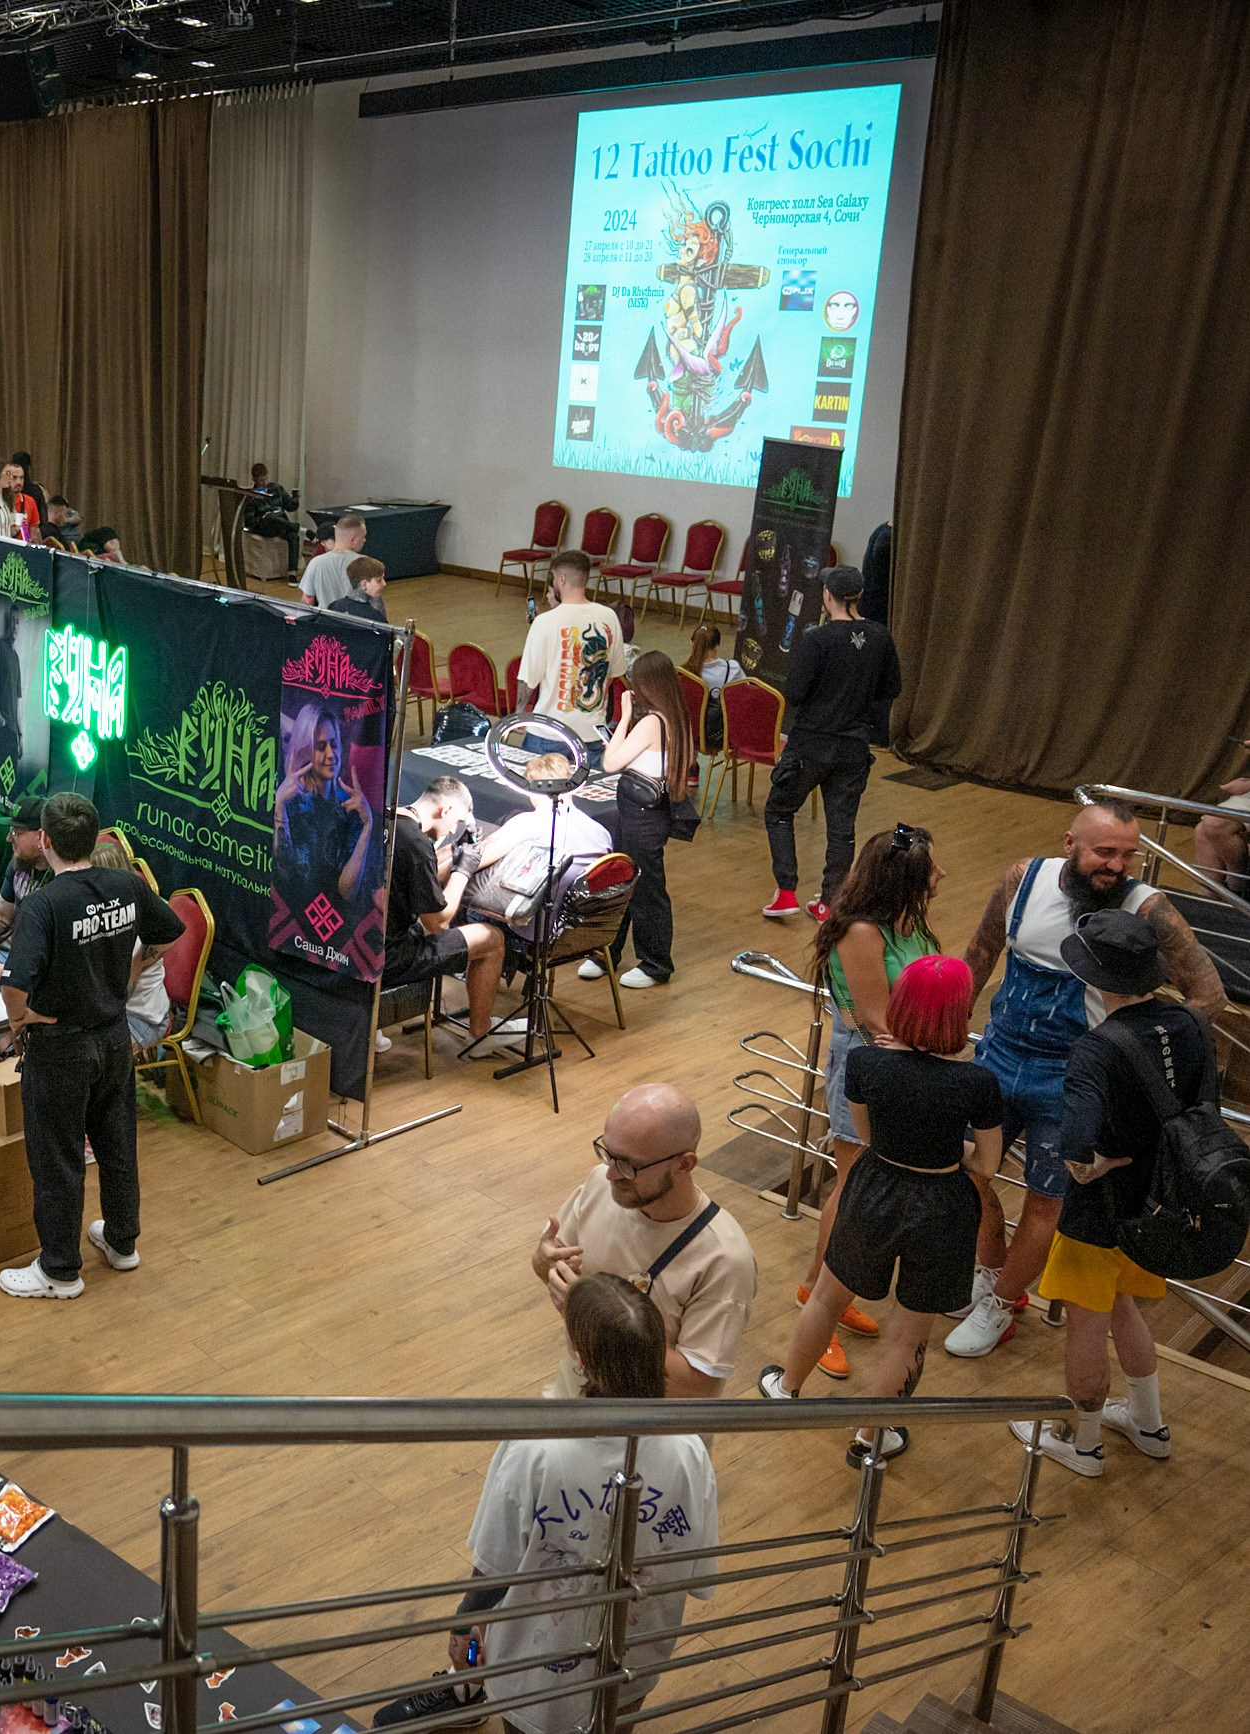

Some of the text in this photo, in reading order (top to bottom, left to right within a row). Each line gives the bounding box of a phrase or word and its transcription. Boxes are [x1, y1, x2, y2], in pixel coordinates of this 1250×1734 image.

[592, 121, 874, 180] 12 Tattoo Fest Sochi
[747, 193, 870, 213] Конгресс холл Sea Galaxy
[603, 209, 637, 232] 2024
[752, 211, 822, 228] Черноморская
[834, 209, 861, 222] Сочи
[813, 394, 850, 411] KARTIN
[294, 935, 349, 966] Саша Джин
